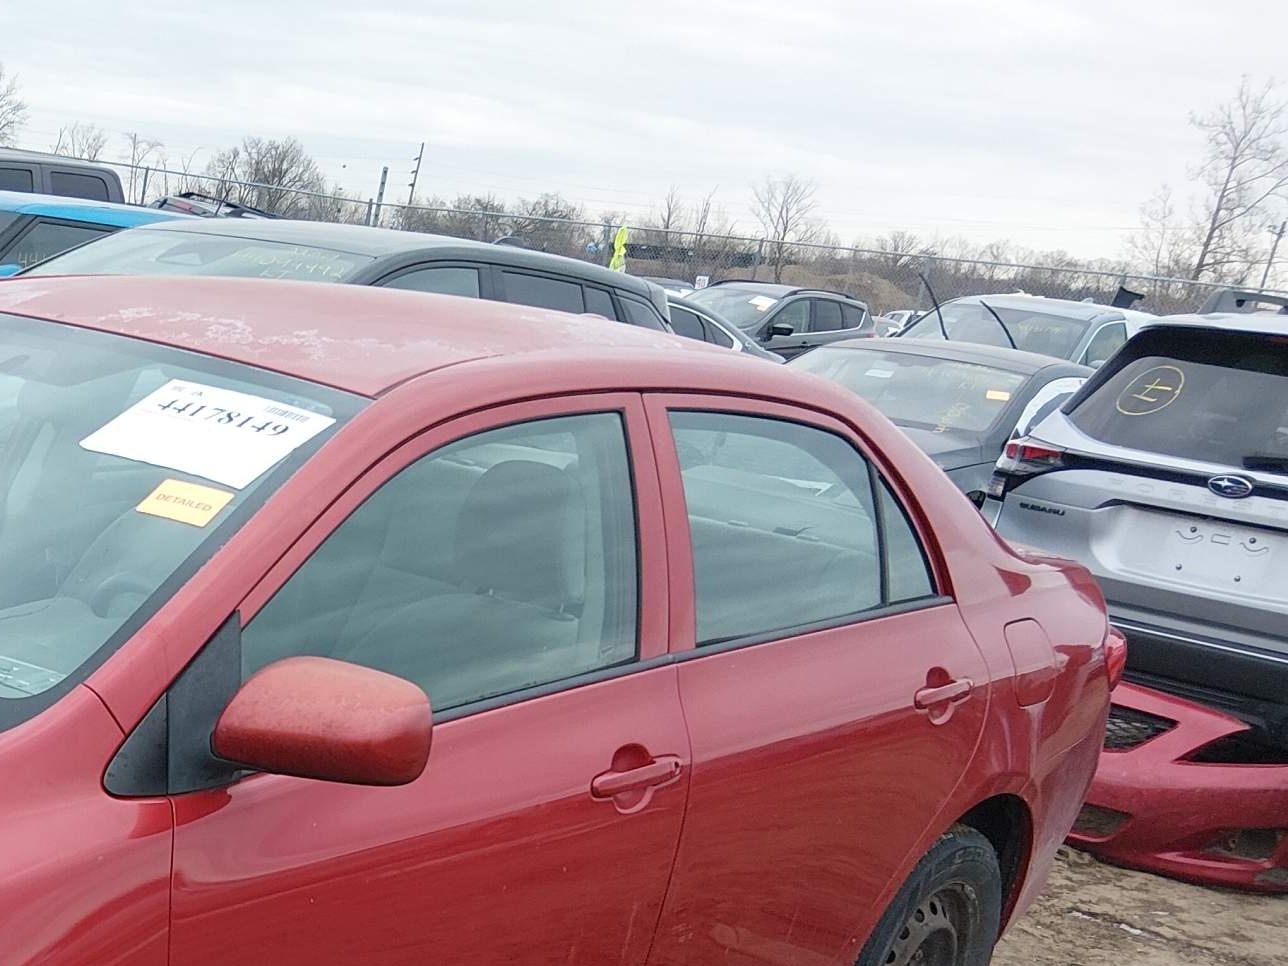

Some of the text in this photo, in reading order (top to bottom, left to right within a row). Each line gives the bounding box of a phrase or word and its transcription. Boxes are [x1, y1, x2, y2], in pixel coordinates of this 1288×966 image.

[157, 399, 290, 437] 44178149
[155, 492, 213, 512] DETAILED
[1019, 502, 1066, 517] SUBARU
